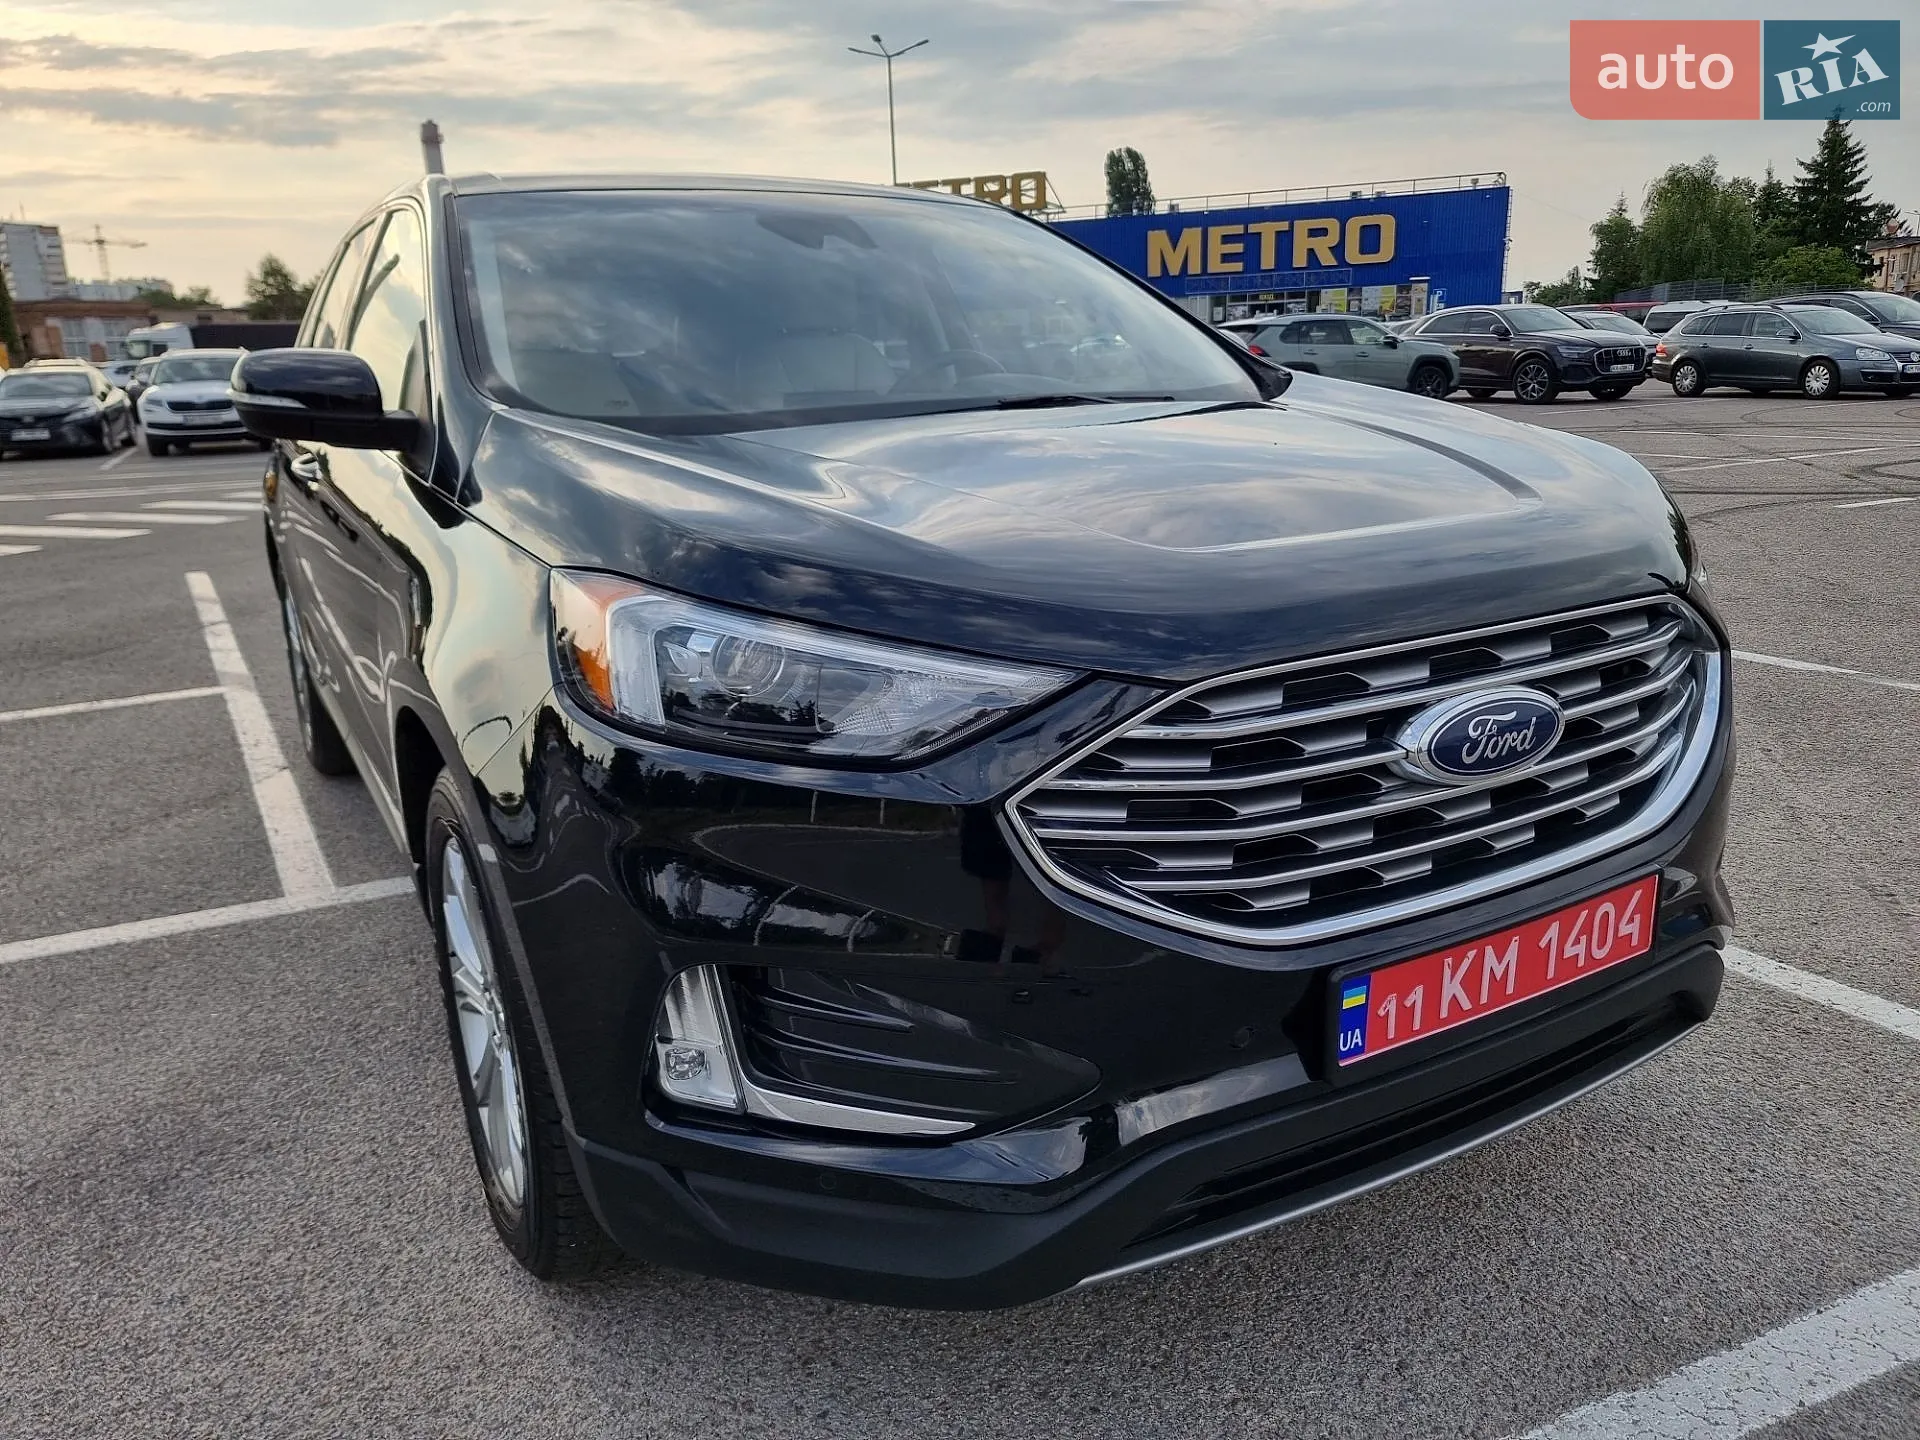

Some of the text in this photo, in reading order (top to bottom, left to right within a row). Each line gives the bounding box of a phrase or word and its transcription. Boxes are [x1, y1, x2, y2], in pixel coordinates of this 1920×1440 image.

[895, 171, 1047, 211] TRO
[1146, 213, 1396, 278] METRO
[1461, 710, 1537, 765] Ford
[1377, 888, 1644, 1040] 11 KM 1404
[1339, 1028, 1363, 1052] UA
